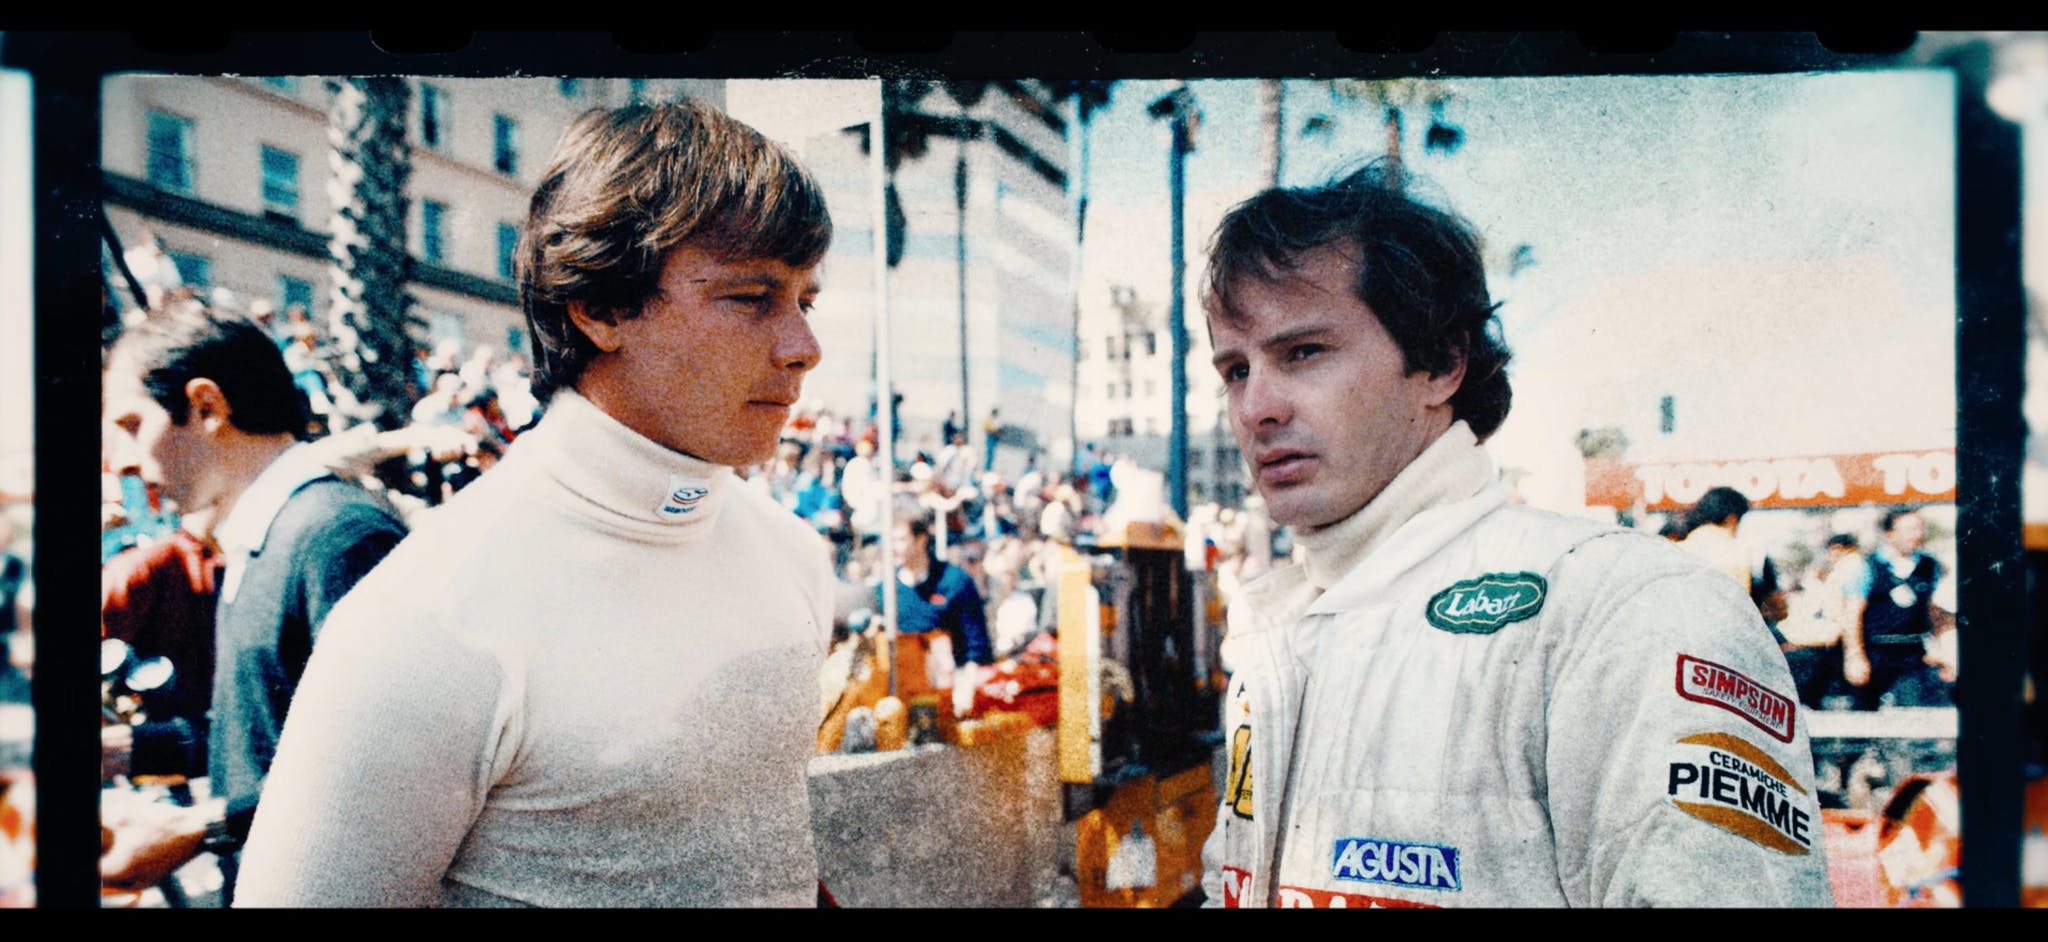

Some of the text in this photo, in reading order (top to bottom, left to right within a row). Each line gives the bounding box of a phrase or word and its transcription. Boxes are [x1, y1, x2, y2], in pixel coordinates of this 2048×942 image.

[1633, 457, 1844, 505] TOYOTA
[1692, 664, 1786, 724] SIMPSON
[1702, 687, 1782, 729] SAFETY EQUIPMENT
[1709, 751, 1788, 798] CERAMICHE
[1668, 763, 1811, 846] PIEMME
[1333, 839, 1457, 888] AGUSTA
